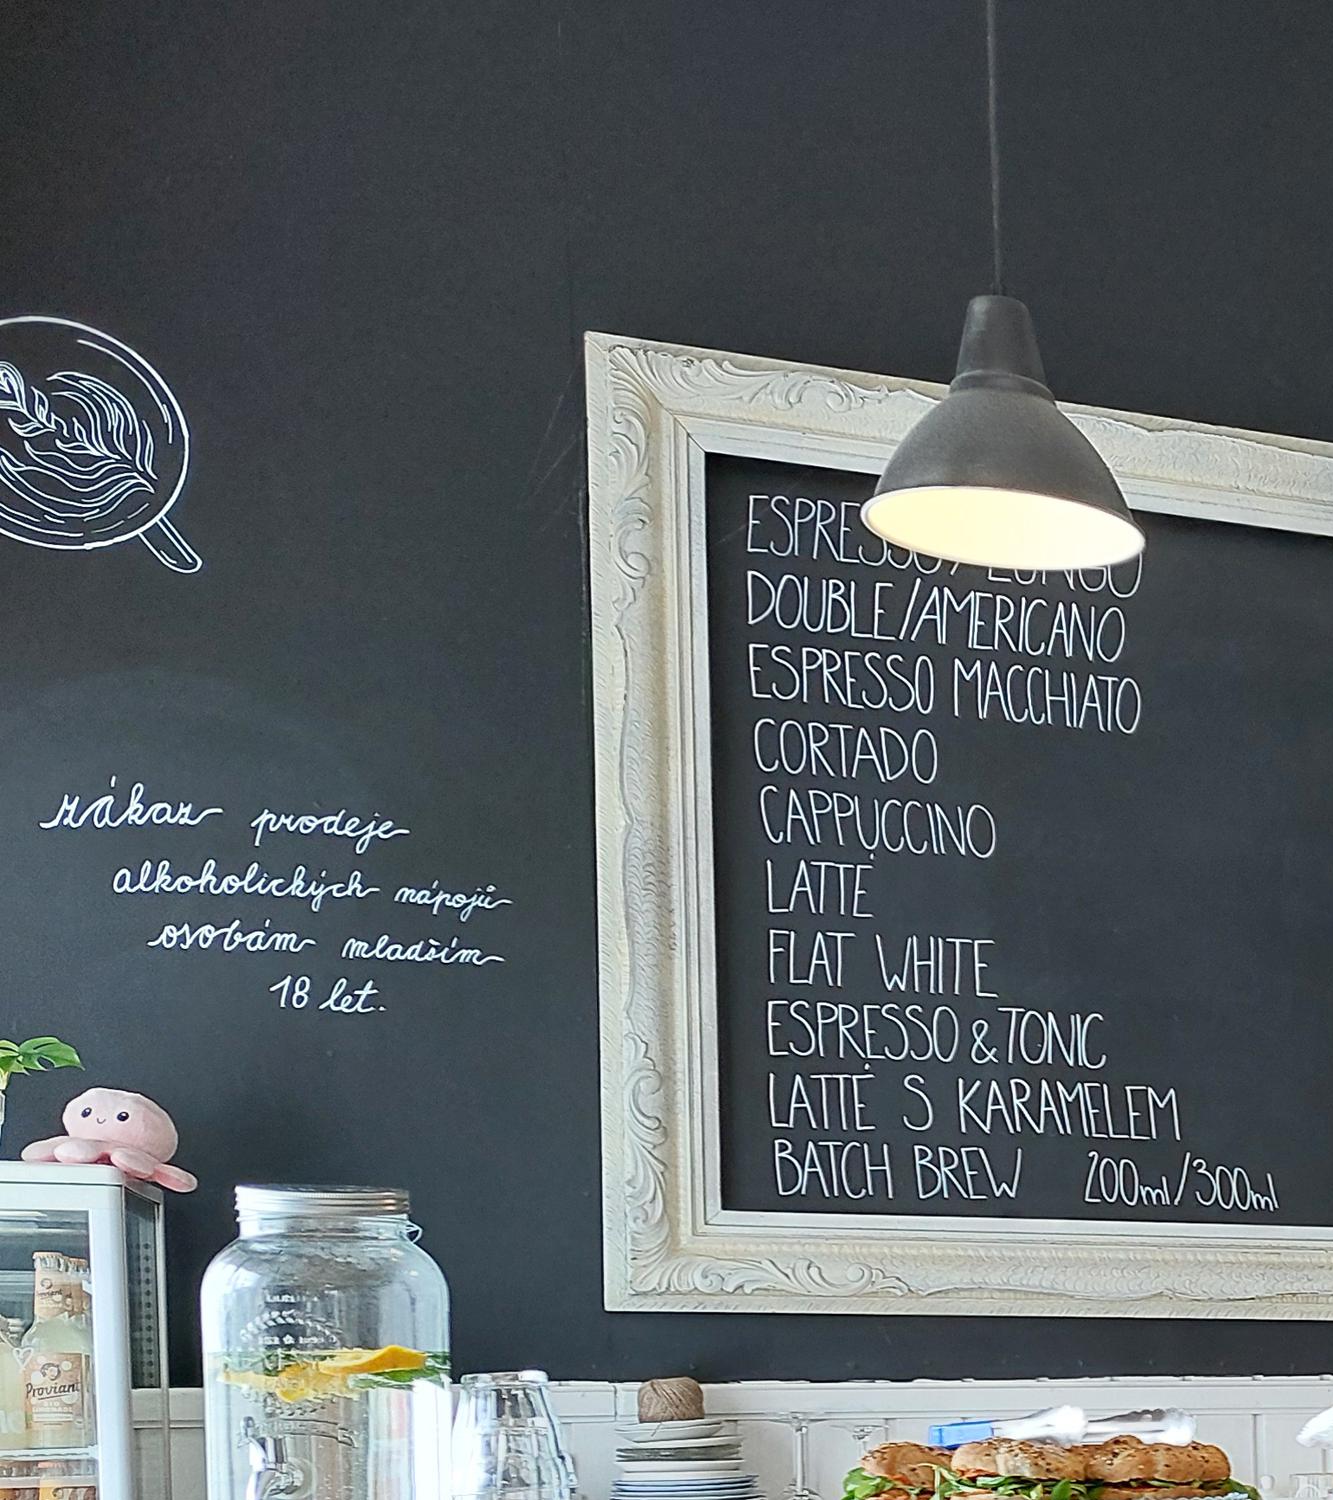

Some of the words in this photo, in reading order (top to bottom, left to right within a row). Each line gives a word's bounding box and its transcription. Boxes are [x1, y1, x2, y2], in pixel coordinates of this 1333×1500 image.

[748, 644, 934, 716] ESPRESSO
[952, 658, 1143, 735] MACCHIATO
[753, 717, 938, 785] CORTADO
[40, 775, 223, 830] zákaz
[251, 808, 410, 854] prodeje
[758, 784, 997, 858] CAPPUCCINO
[113, 859, 380, 912] alkoholických
[395, 880, 512, 921] nápojů
[148, 919, 316, 954] osobám
[341, 937, 505, 967] mladším
[768, 929, 856, 988] FLAT
[876, 935, 998, 999] WHITE
[270, 975, 310, 1009] 18
[319, 978, 386, 1014] let.
[767, 1000, 960, 1064] ESPRESSO
[903, 1077, 934, 1134] S
[957, 1077, 1182, 1143] KARAMELEM
[774, 1140, 892, 1201] BATCH
[914, 1146, 1023, 1200] BREW
[26, 1381, 80, 1400] Proviant
